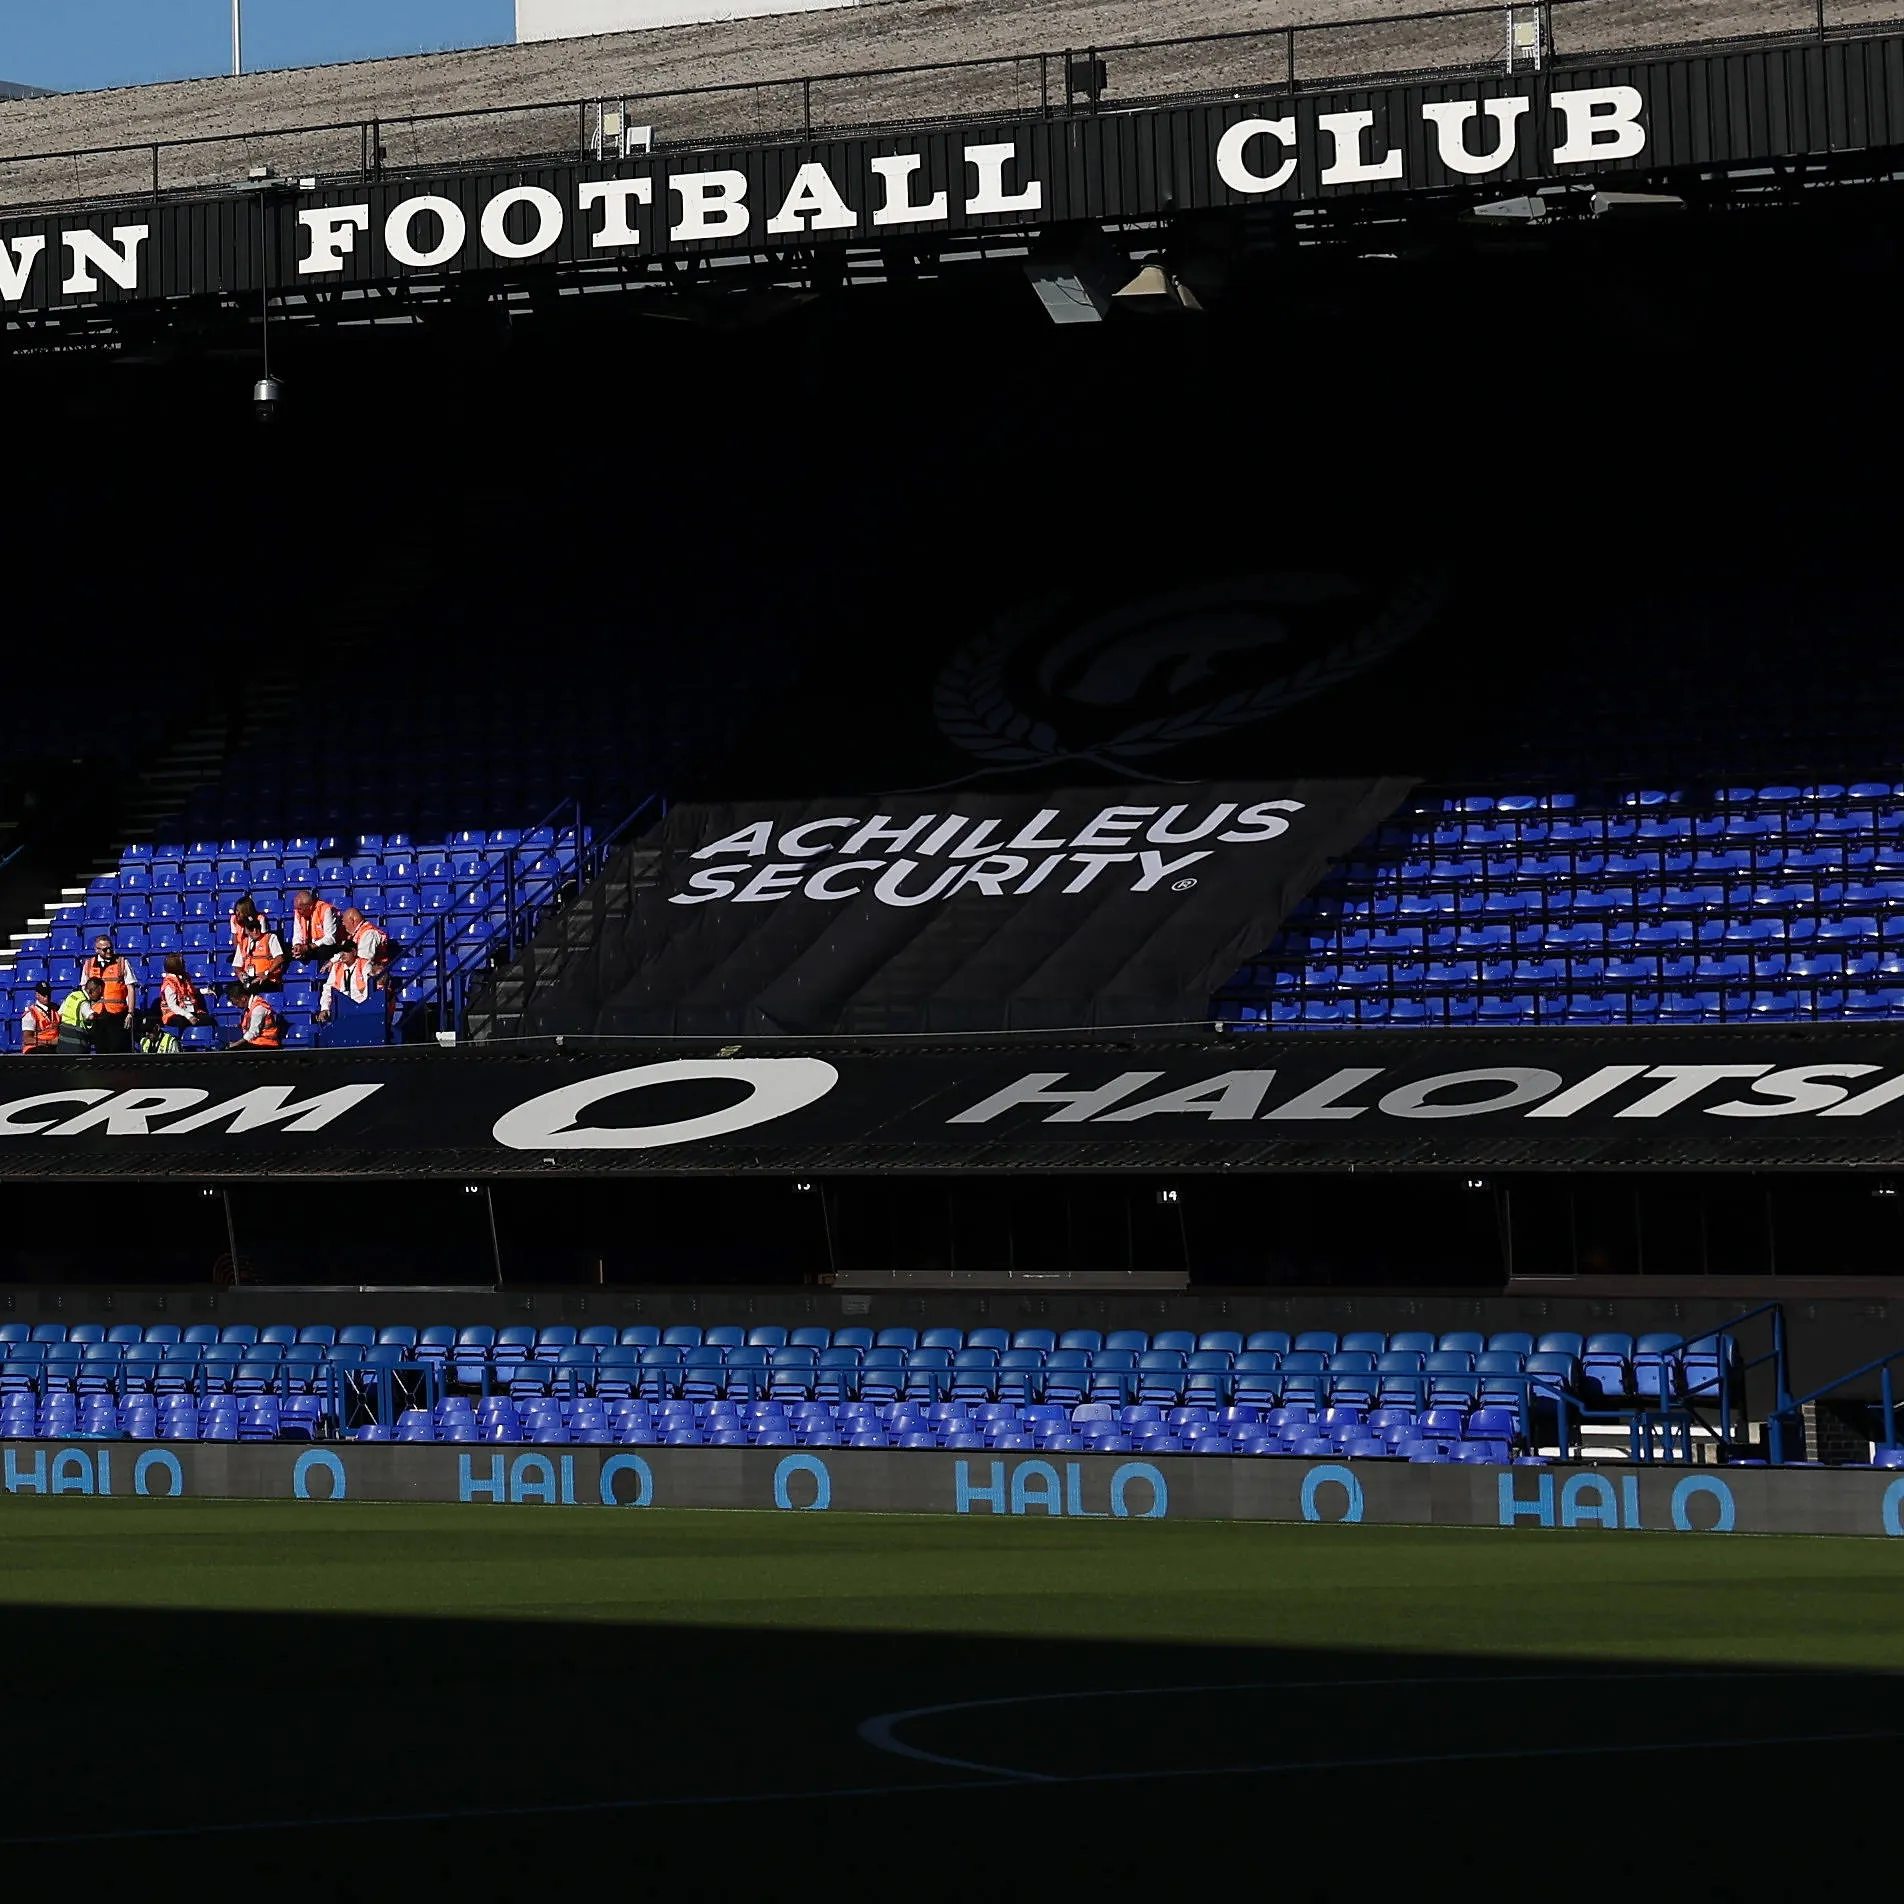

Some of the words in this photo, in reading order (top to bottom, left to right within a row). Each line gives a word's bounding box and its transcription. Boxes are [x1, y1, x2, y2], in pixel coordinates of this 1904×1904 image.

[298, 142, 1043, 275] FOOTBALL
[1216, 85, 1646, 194] CLUB
[687, 799, 1306, 862] ACHILLEUS
[945, 1063, 1904, 1124] HALOITS
[1162, 1190, 1177, 1201] 14
[4, 1447, 184, 1497] HALO
[459, 1452, 654, 1506] HALO
[955, 1459, 1169, 1519] HALO
[1498, 1472, 1736, 1532] HALO
